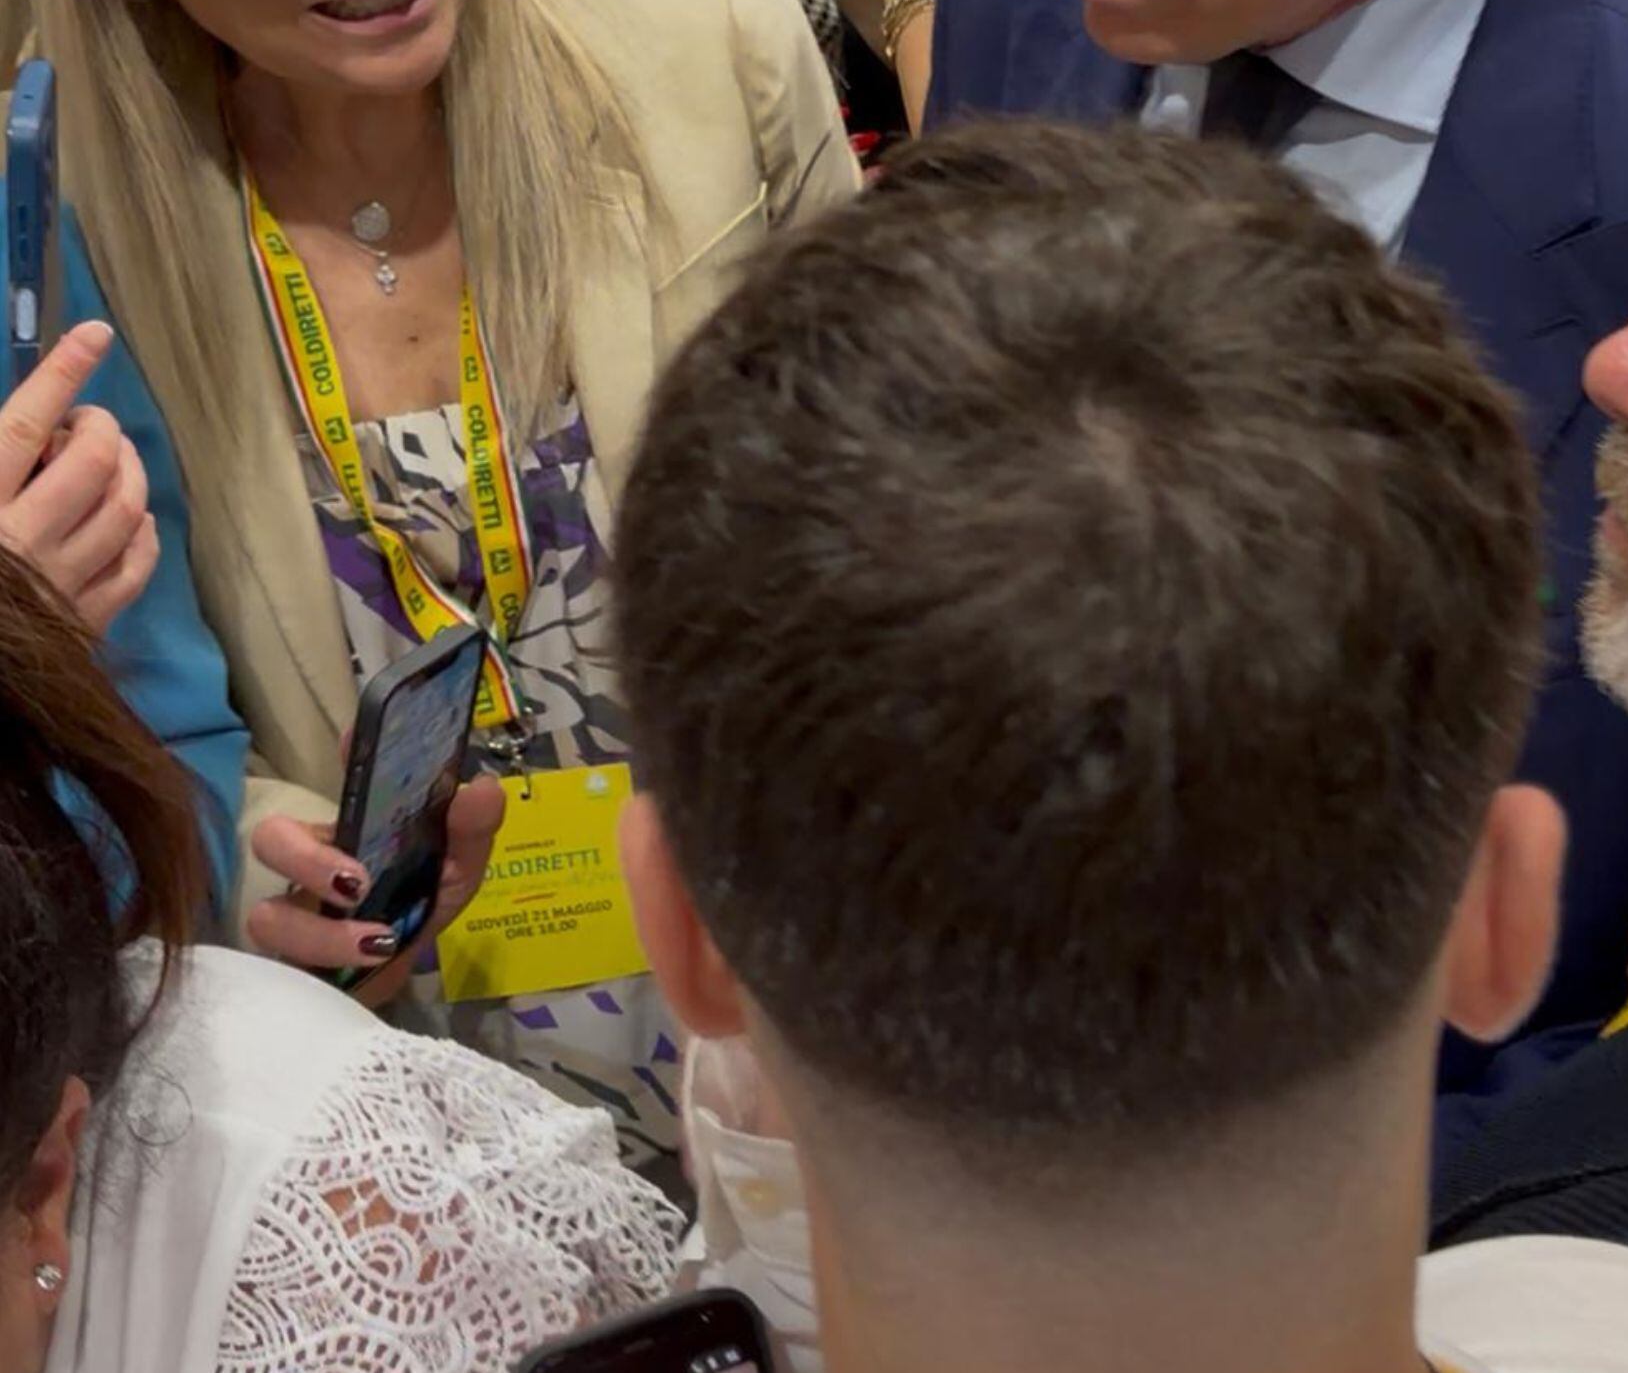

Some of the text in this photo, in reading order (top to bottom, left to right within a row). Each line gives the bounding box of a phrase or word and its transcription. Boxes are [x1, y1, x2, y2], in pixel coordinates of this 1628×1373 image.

[285, 273, 335, 396] COLDIRETTI
[467, 405, 503, 530] COLDIRETTI
[484, 848, 602, 882] OLDIRETTI
